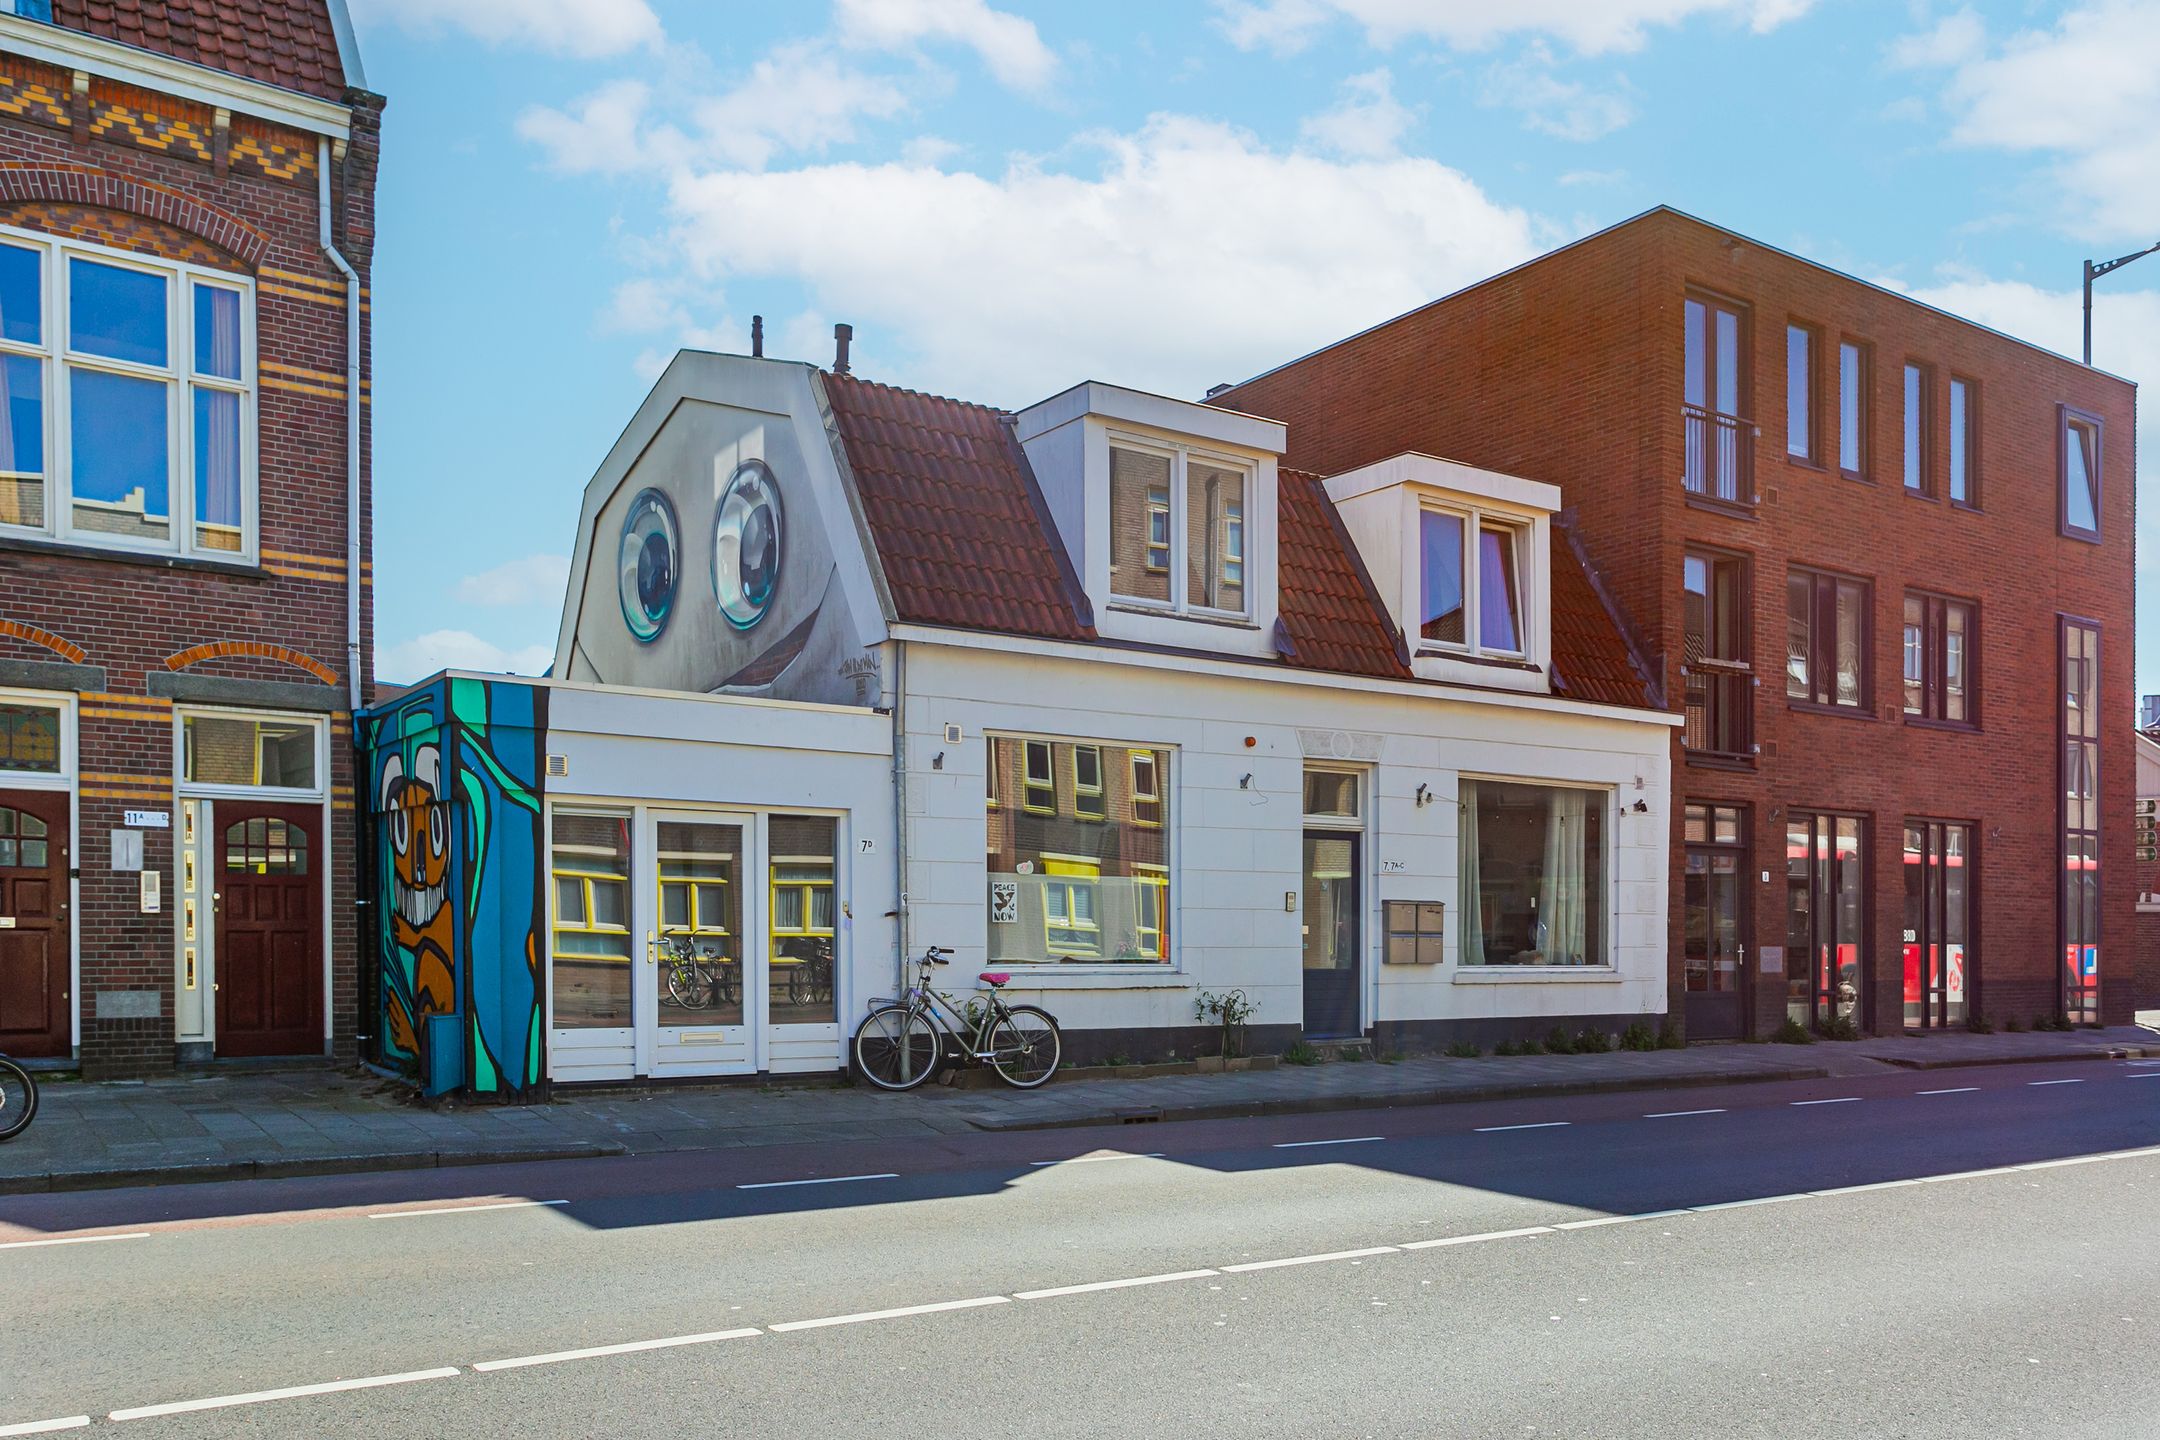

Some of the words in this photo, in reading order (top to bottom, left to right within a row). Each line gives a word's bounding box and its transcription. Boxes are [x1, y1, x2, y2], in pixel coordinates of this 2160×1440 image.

[861, 840, 873, 852] 7D
[993, 883, 1015, 891] PEACE
[993, 912, 1016, 921] NOW
